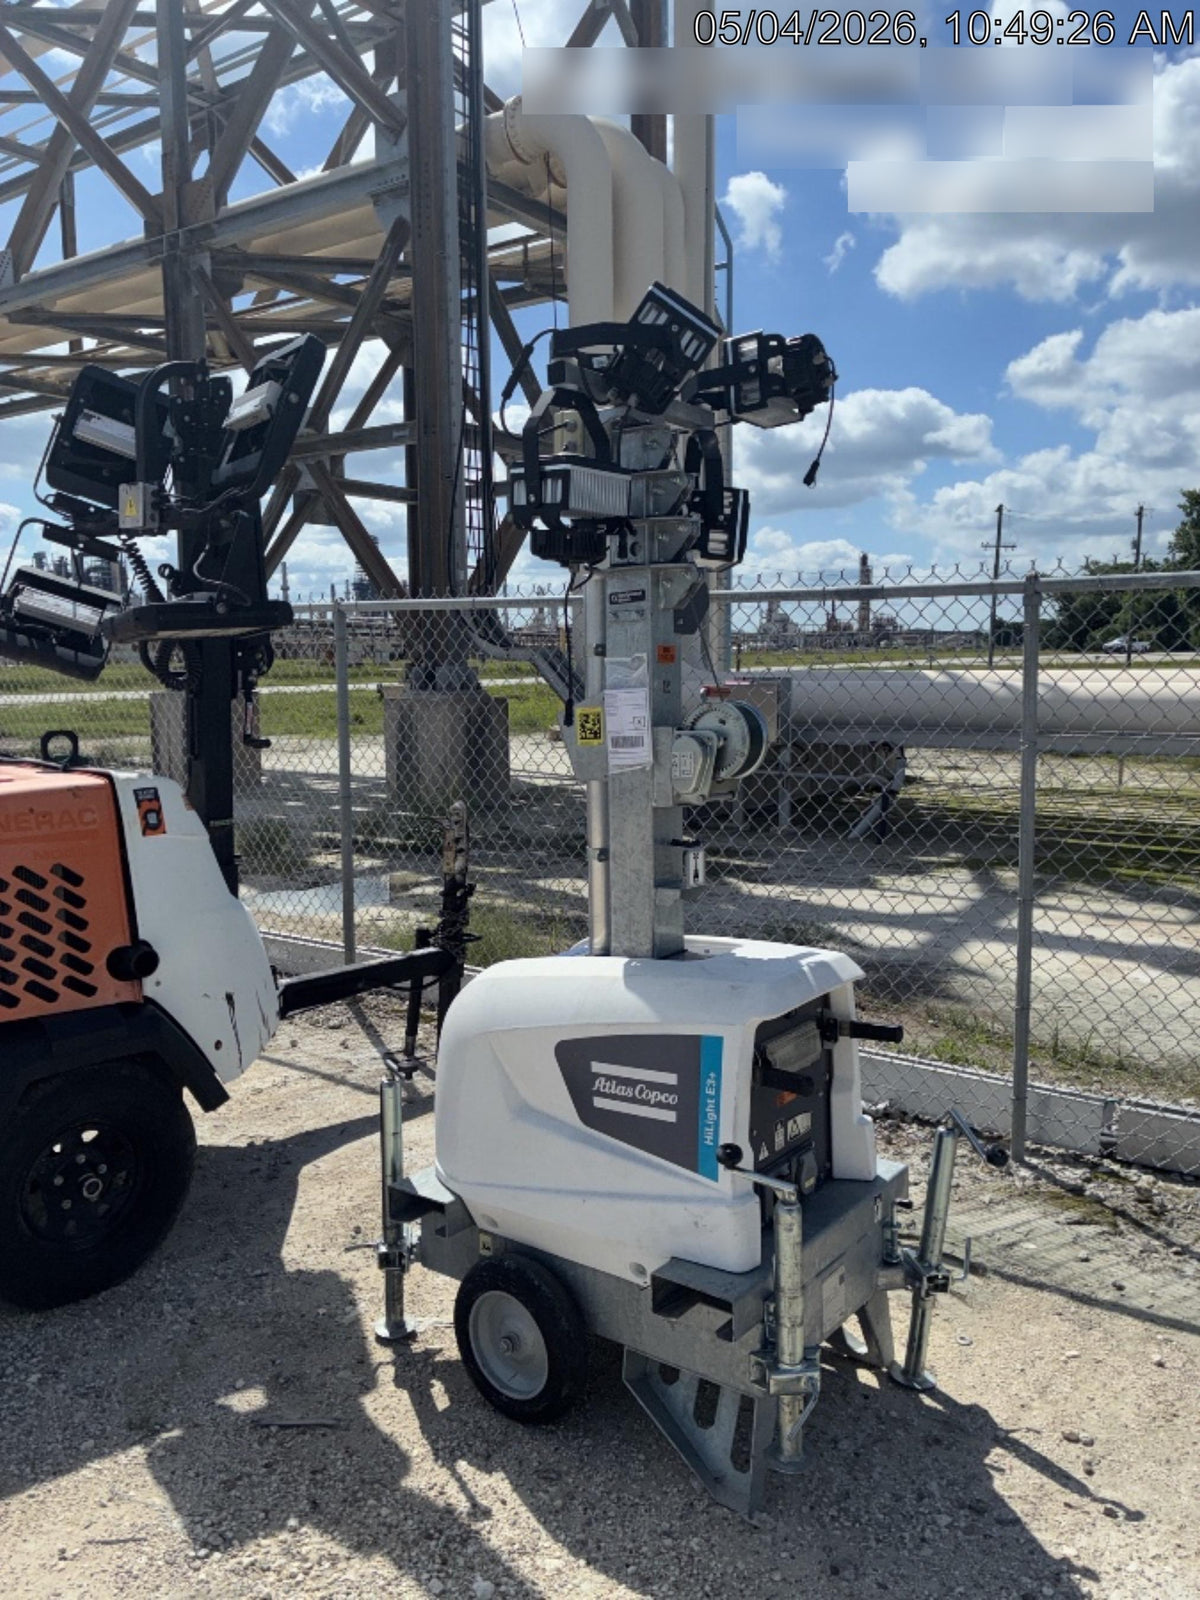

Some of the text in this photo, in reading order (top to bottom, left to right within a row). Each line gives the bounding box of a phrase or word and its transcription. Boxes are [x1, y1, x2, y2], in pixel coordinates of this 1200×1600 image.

[592, 1076, 679, 1105] Atlas Copco
[703, 1071, 718, 1147] HiLight E3+
